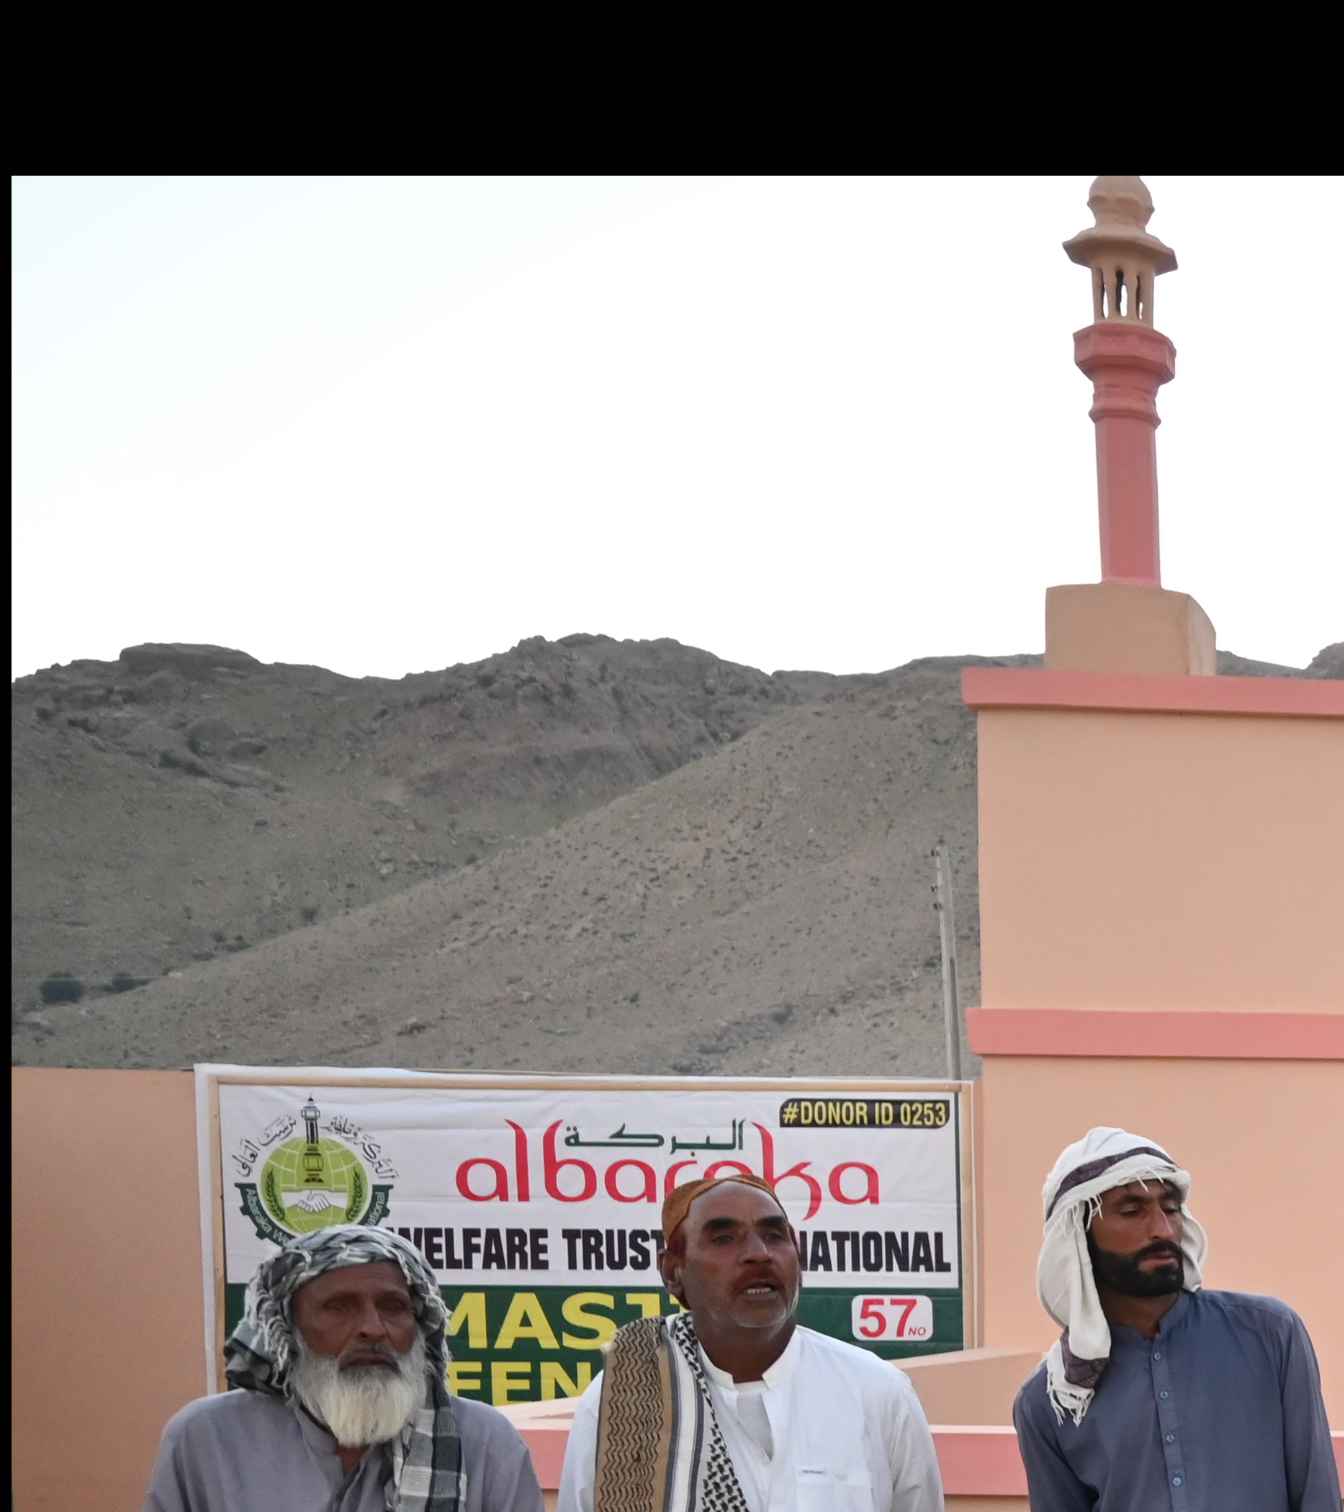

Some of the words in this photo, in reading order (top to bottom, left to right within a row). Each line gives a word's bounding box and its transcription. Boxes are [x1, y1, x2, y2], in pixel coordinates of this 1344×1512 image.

[782, 1101, 869, 1125] #DONOR
[874, 1102, 894, 1125] ID
[900, 1102, 947, 1126] 0253
[859, 1297, 918, 1338] 57
[908, 1327, 926, 1337] NO
